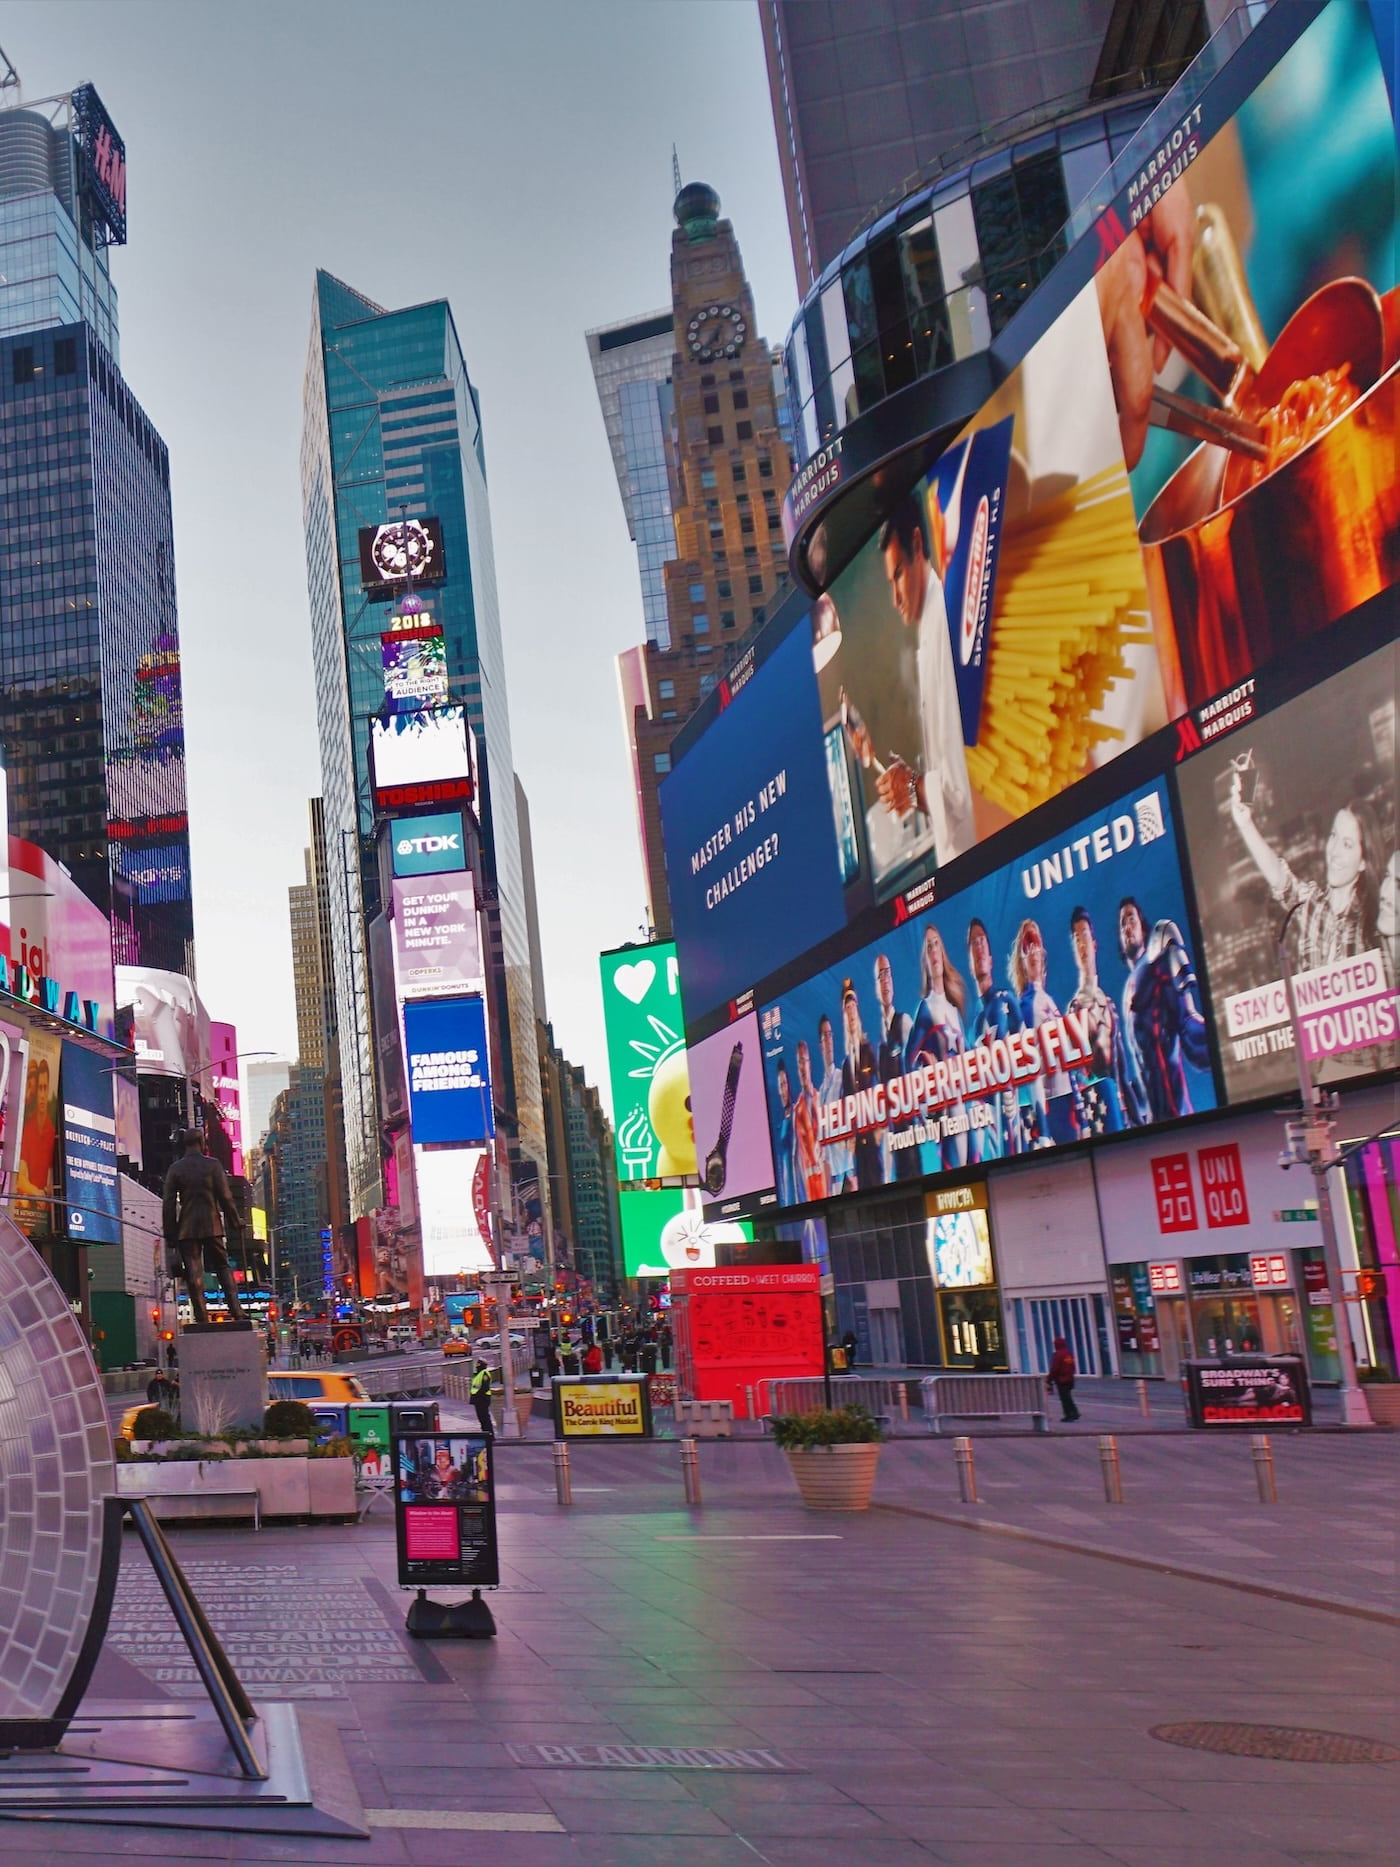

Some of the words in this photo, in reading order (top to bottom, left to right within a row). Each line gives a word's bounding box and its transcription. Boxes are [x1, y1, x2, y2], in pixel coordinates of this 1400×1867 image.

[1128, 104, 1202, 202] MARRIOTT
[1130, 139, 1200, 228] MARQUIS
[791, 437, 845, 501] MARRIOTT
[793, 464, 840, 521] MARQUIS
[391, 613, 432, 631] 2018
[382, 625, 443, 643] TOSHIBA
[730, 647, 756, 682] MARRIOTT
[396, 684, 441, 696] AUDIENCE
[730, 664, 755, 697] MARQUIS
[1200, 679, 1256, 723] MARRIOTT
[1202, 700, 1253, 740] MARQUIS
[377, 781, 472, 806] TOSHIBA
[691, 827, 733, 876] MASTER
[734, 804, 757, 837] HIS
[759, 769, 787, 815] NEW
[411, 833, 459, 853] TDK
[1022, 813, 1136, 900] UNITED
[706, 832, 780, 910] CHALLENGE?
[402, 895, 424, 906] GET
[426, 892, 459, 903] YOUR
[906, 877, 936, 902] MARRIOTT
[403, 904, 450, 917] DUNKIN'
[908, 891, 935, 913] MARQUIS
[404, 917, 417, 927] IN
[418, 916, 428, 926] A
[405, 927, 433, 938] NEW
[434, 924, 466, 935] YORK
[405, 937, 452, 949] MINUTE.
[1233, 995, 1270, 1027] STAY
[1233, 1030, 1269, 1062] WITH
[1268, 1025, 1296, 1053] THE
[411, 1050, 478, 1068] FAMOUS
[411, 1063, 473, 1080] AMONG
[818, 1083, 887, 1142] HELPING
[887, 1029, 1042, 1120] SUPERHEROES
[1038, 1009, 1094, 1070] FLY
[412, 1075, 486, 1093] FRIENDS.
[887, 1129, 913, 1152] Proud
[915, 1127, 927, 1144] to
[927, 1119, 941, 1145] fly
[942, 1112, 968, 1138] Team
[968, 1103, 994, 1130] USA
[1204, 1154, 1237, 1186] UNI
[1208, 1188, 1244, 1219] QLO
[693, 1275, 750, 1287] COFFEED
[755, 1273, 780, 1285] SWEET
[781, 1273, 816, 1284] CHURROS
[1201, 1368, 1281, 1379] BROADWAY'S
[1202, 1378, 1236, 1388] SURE
[563, 1398, 638, 1417] Beautiful
[1203, 1404, 1303, 1420] CHICAGO
[566, 1418, 577, 1426] The
[578, 1418, 598, 1426] Carole
[599, 1418, 614, 1427] King
[108, 1631, 397, 1642] AMSSADOR
[156, 1668, 320, 1682] BRDWAY
[535, 1744, 786, 1768] BEAUMONT
